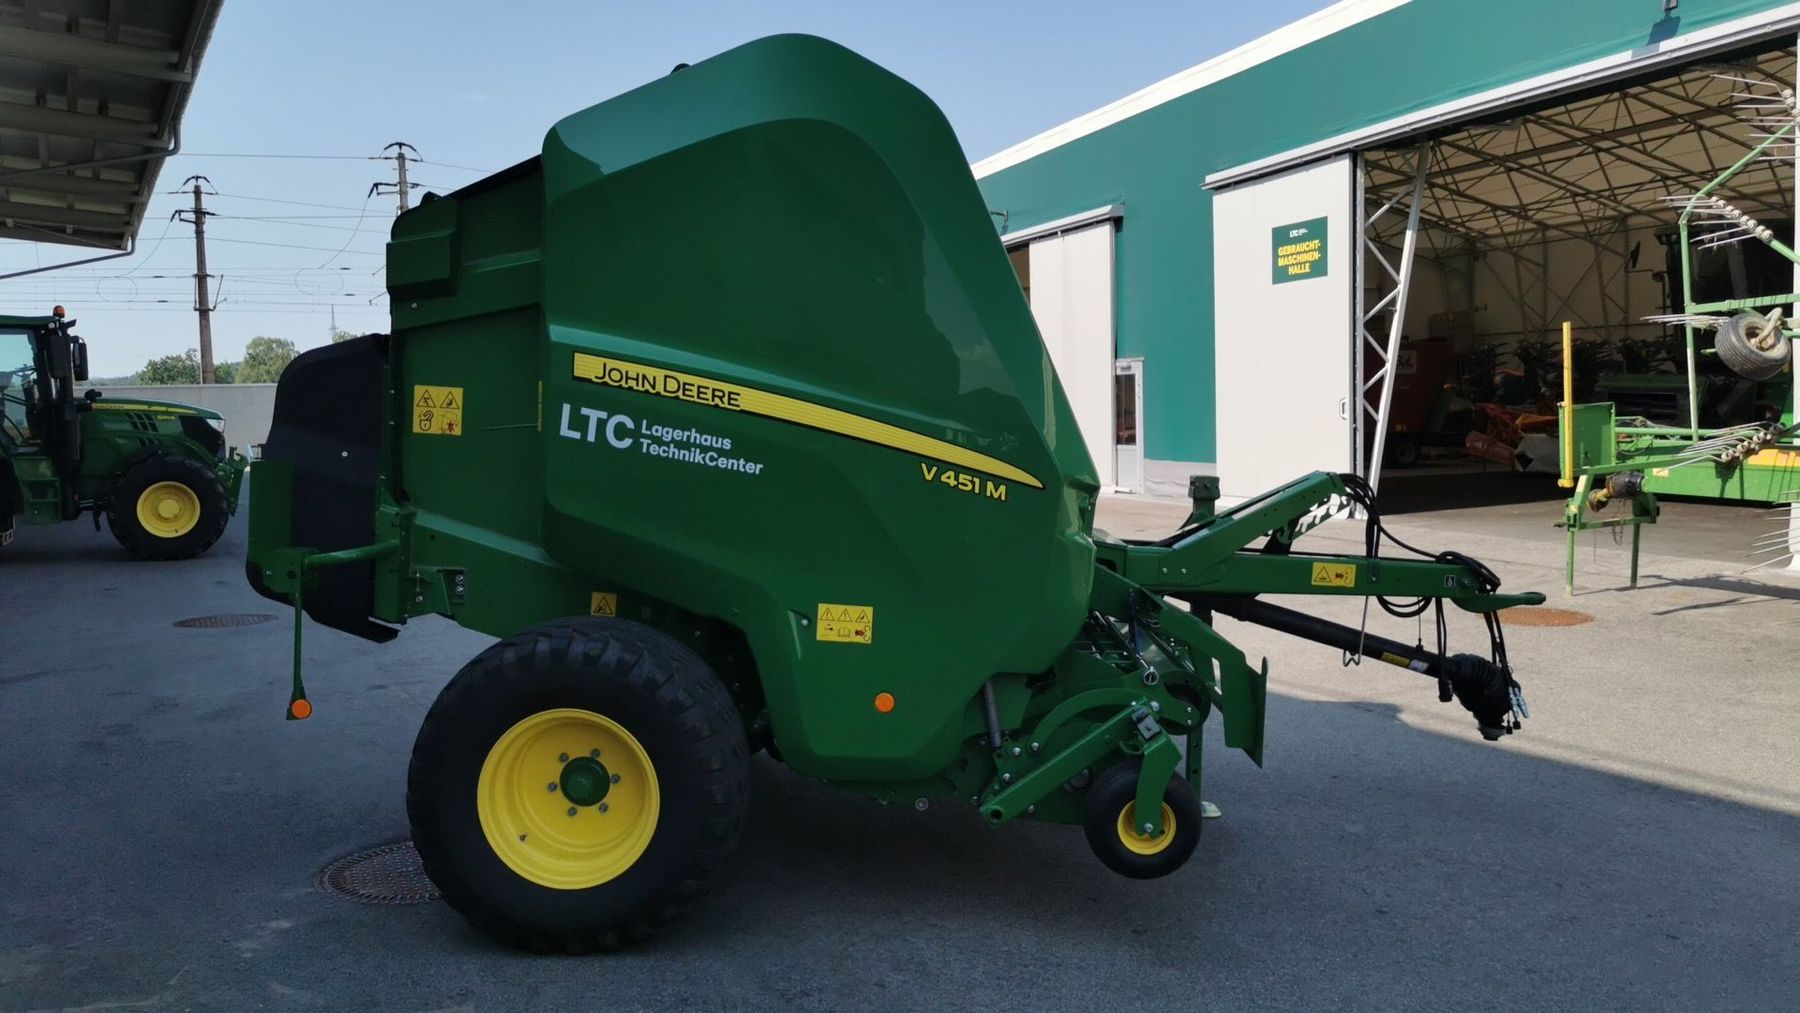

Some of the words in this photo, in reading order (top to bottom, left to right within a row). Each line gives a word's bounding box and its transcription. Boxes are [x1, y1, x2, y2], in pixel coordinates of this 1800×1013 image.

[1278, 240, 1320, 256] GEBRAUCHT-
[1278, 251, 1320, 266] MASCHINEN-
[1288, 263, 1310, 275] HALLE
[595, 362, 656, 391] JOHN
[663, 374, 741, 407] DEERE
[560, 403, 635, 449] LTC
[641, 419, 732, 450] Lagerhaus
[640, 438, 763, 474] TechnikCenter
[921, 462, 938, 481] V
[940, 470, 980, 494] 451
[986, 481, 1007, 501] M
